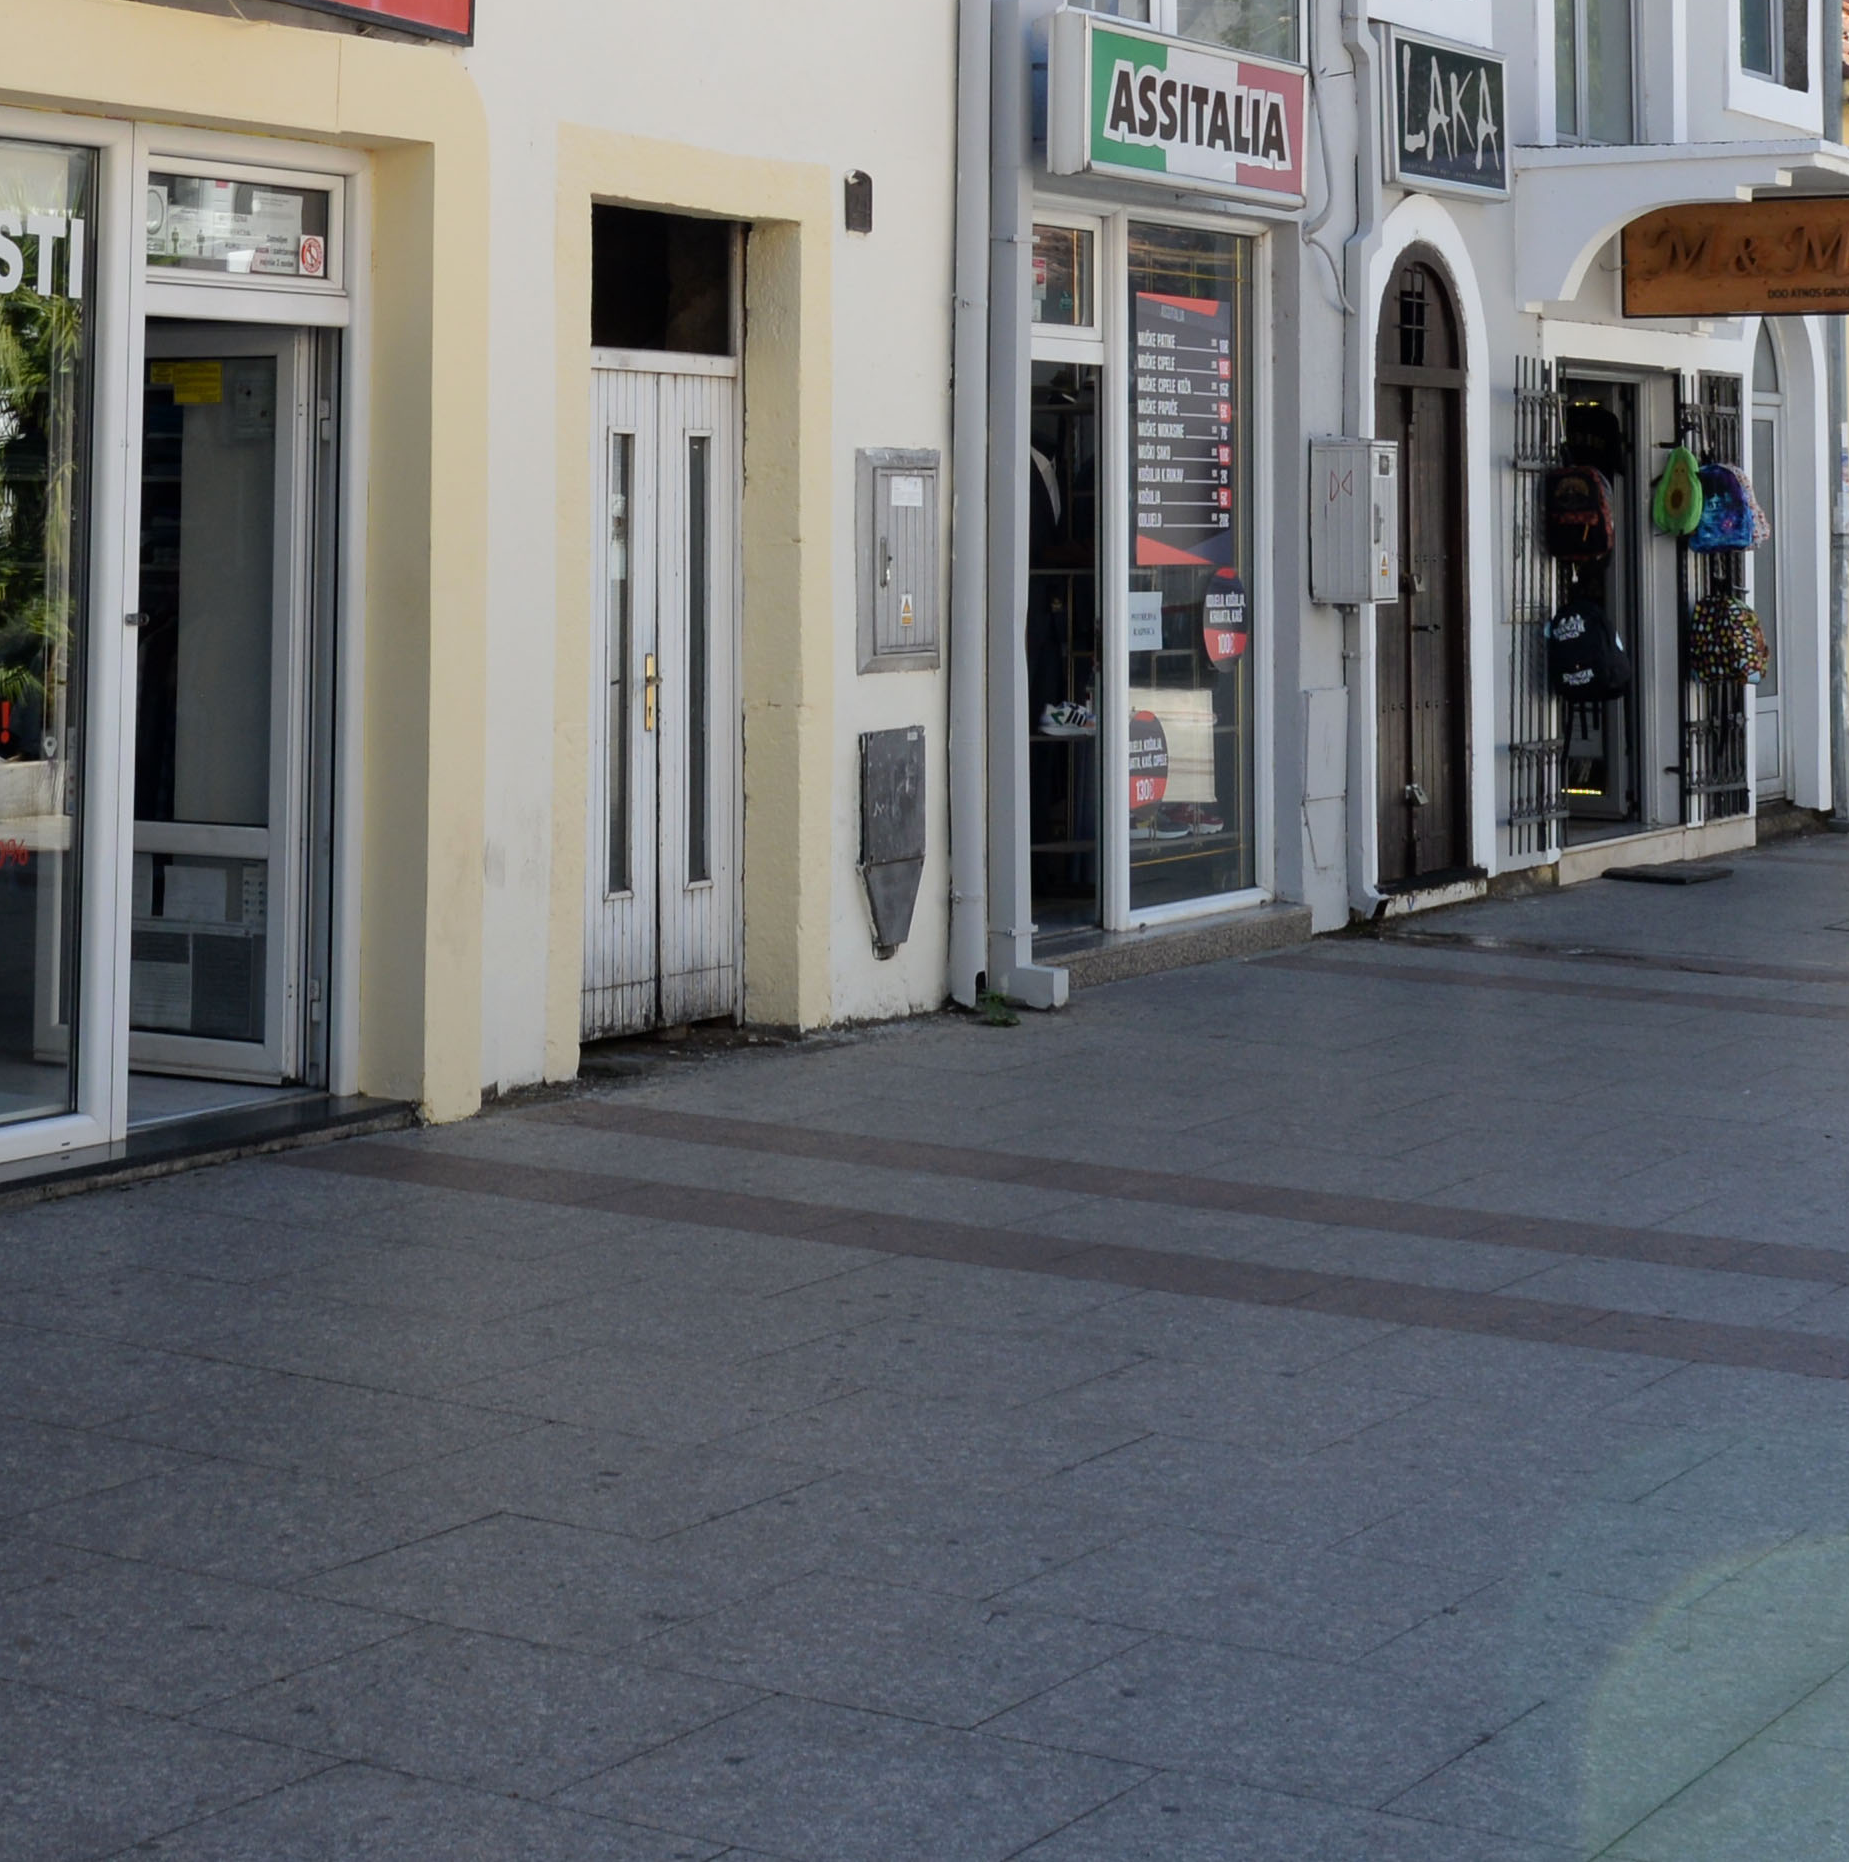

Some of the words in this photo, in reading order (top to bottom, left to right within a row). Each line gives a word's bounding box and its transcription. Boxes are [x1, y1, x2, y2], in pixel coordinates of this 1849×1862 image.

[1109, 68, 1287, 163] ASSITALIA
[1402, 42, 1500, 171] LAKA
[1646, 220, 1724, 280] M
[1728, 236, 1774, 278] &
